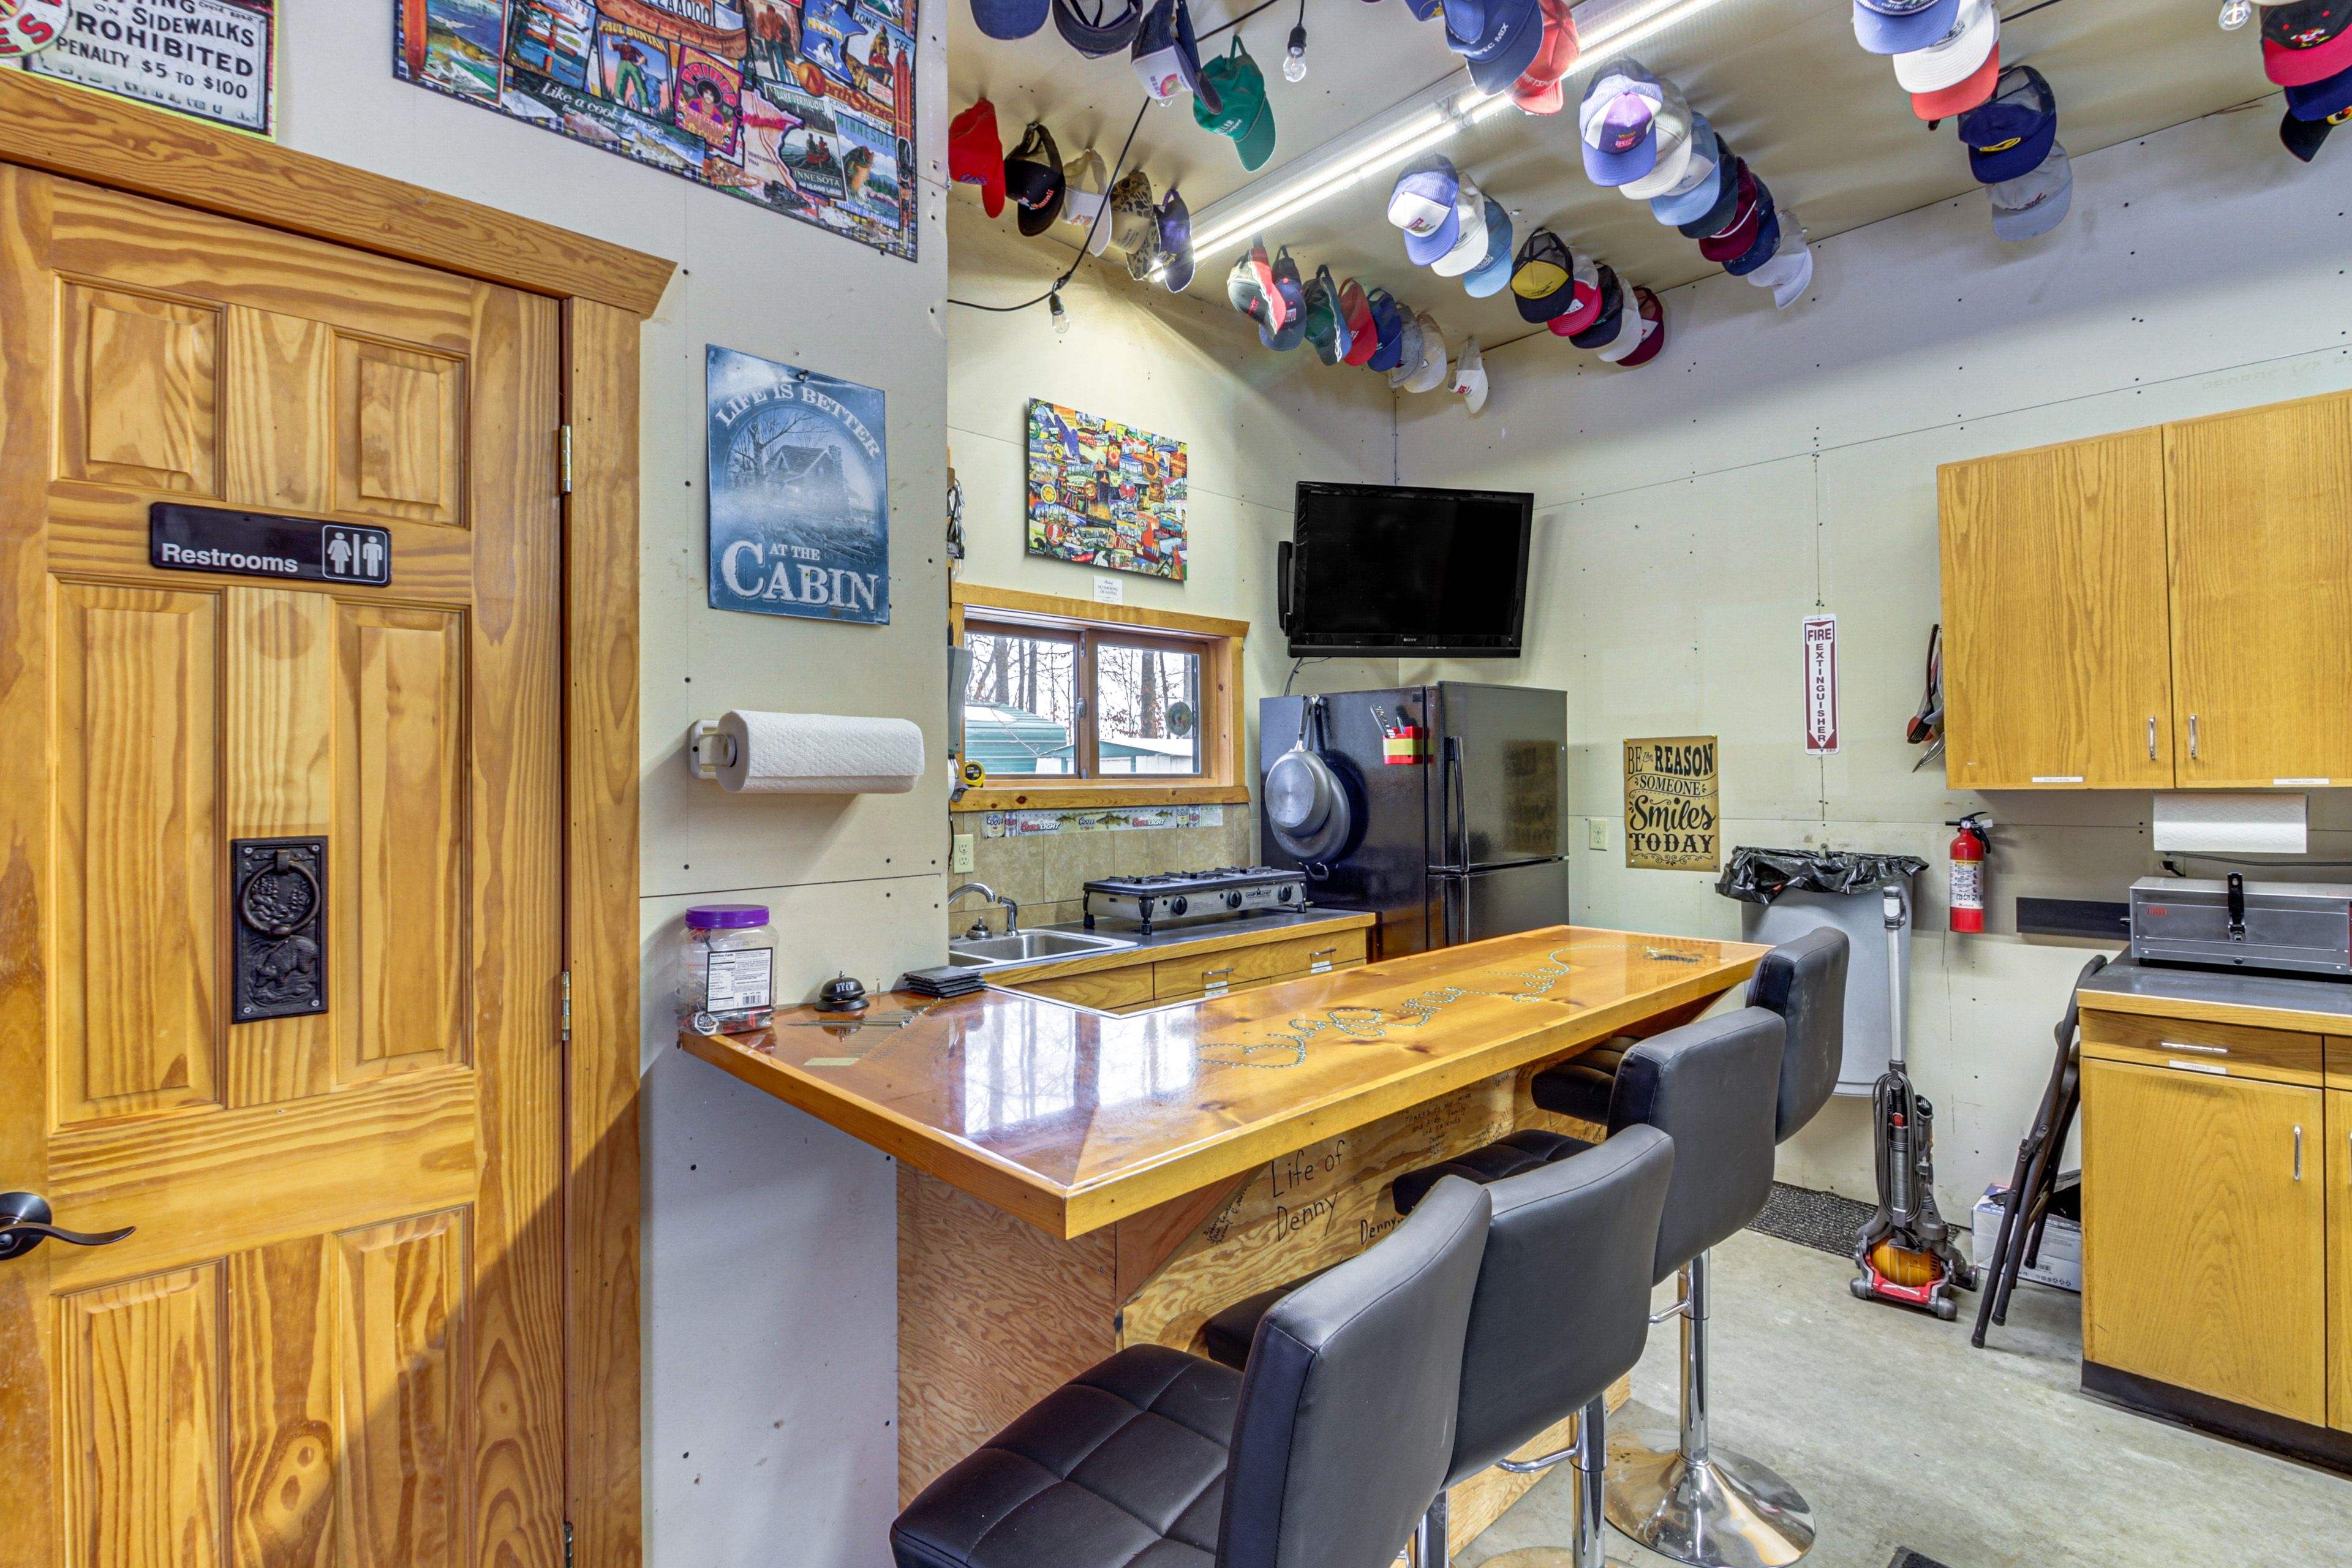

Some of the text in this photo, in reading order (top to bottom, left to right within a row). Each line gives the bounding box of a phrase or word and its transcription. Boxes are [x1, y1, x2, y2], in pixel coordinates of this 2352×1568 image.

[94, 4, 119, 15] ON
[853, 12, 878, 31] COME
[132, 7, 254, 47] SIDEWALKS
[598, 21, 667, 54] PAUL BUNYAN
[1494, 23, 1510, 42] MIX
[72, 8, 253, 77] ROHIBITED
[56, 36, 247, 99] PENALTY $5 TO $100
[681, 63, 737, 107] PRINCE
[541, 83, 572, 102] Like
[575, 98, 585, 108] a
[587, 102, 618, 120] cool
[622, 109, 665, 137] breeze
[828, 97, 850, 111] SCENIC
[837, 115, 895, 149] MINNESOTA
[860, 113, 891, 130] RAILROAD
[793, 170, 840, 187] INNESOTA
[1030, 189, 1055, 209] Hawaii
[715, 383, 881, 458] LIFE IS BETTER
[162, 543, 298, 573] Restrooms
[769, 543, 820, 561] AT THE
[722, 540, 879, 612] CABIN
[1807, 628, 1831, 641] FIRE
[1815, 643, 1826, 742] EXTINGUISHER
[1627, 743, 1714, 777] BE The REASON
[1639, 774, 1701, 796] SOMEONE
[986, 816, 1004, 826] Coors
[1078, 816, 1095, 826] Coors
[1629, 794, 1716, 832] Smiles
[1628, 832, 1714, 854] TODAY
[836, 984, 854, 993] BEER
[1272, 1139, 1346, 1198] Life of
[1277, 1191, 1338, 1242] Denny
